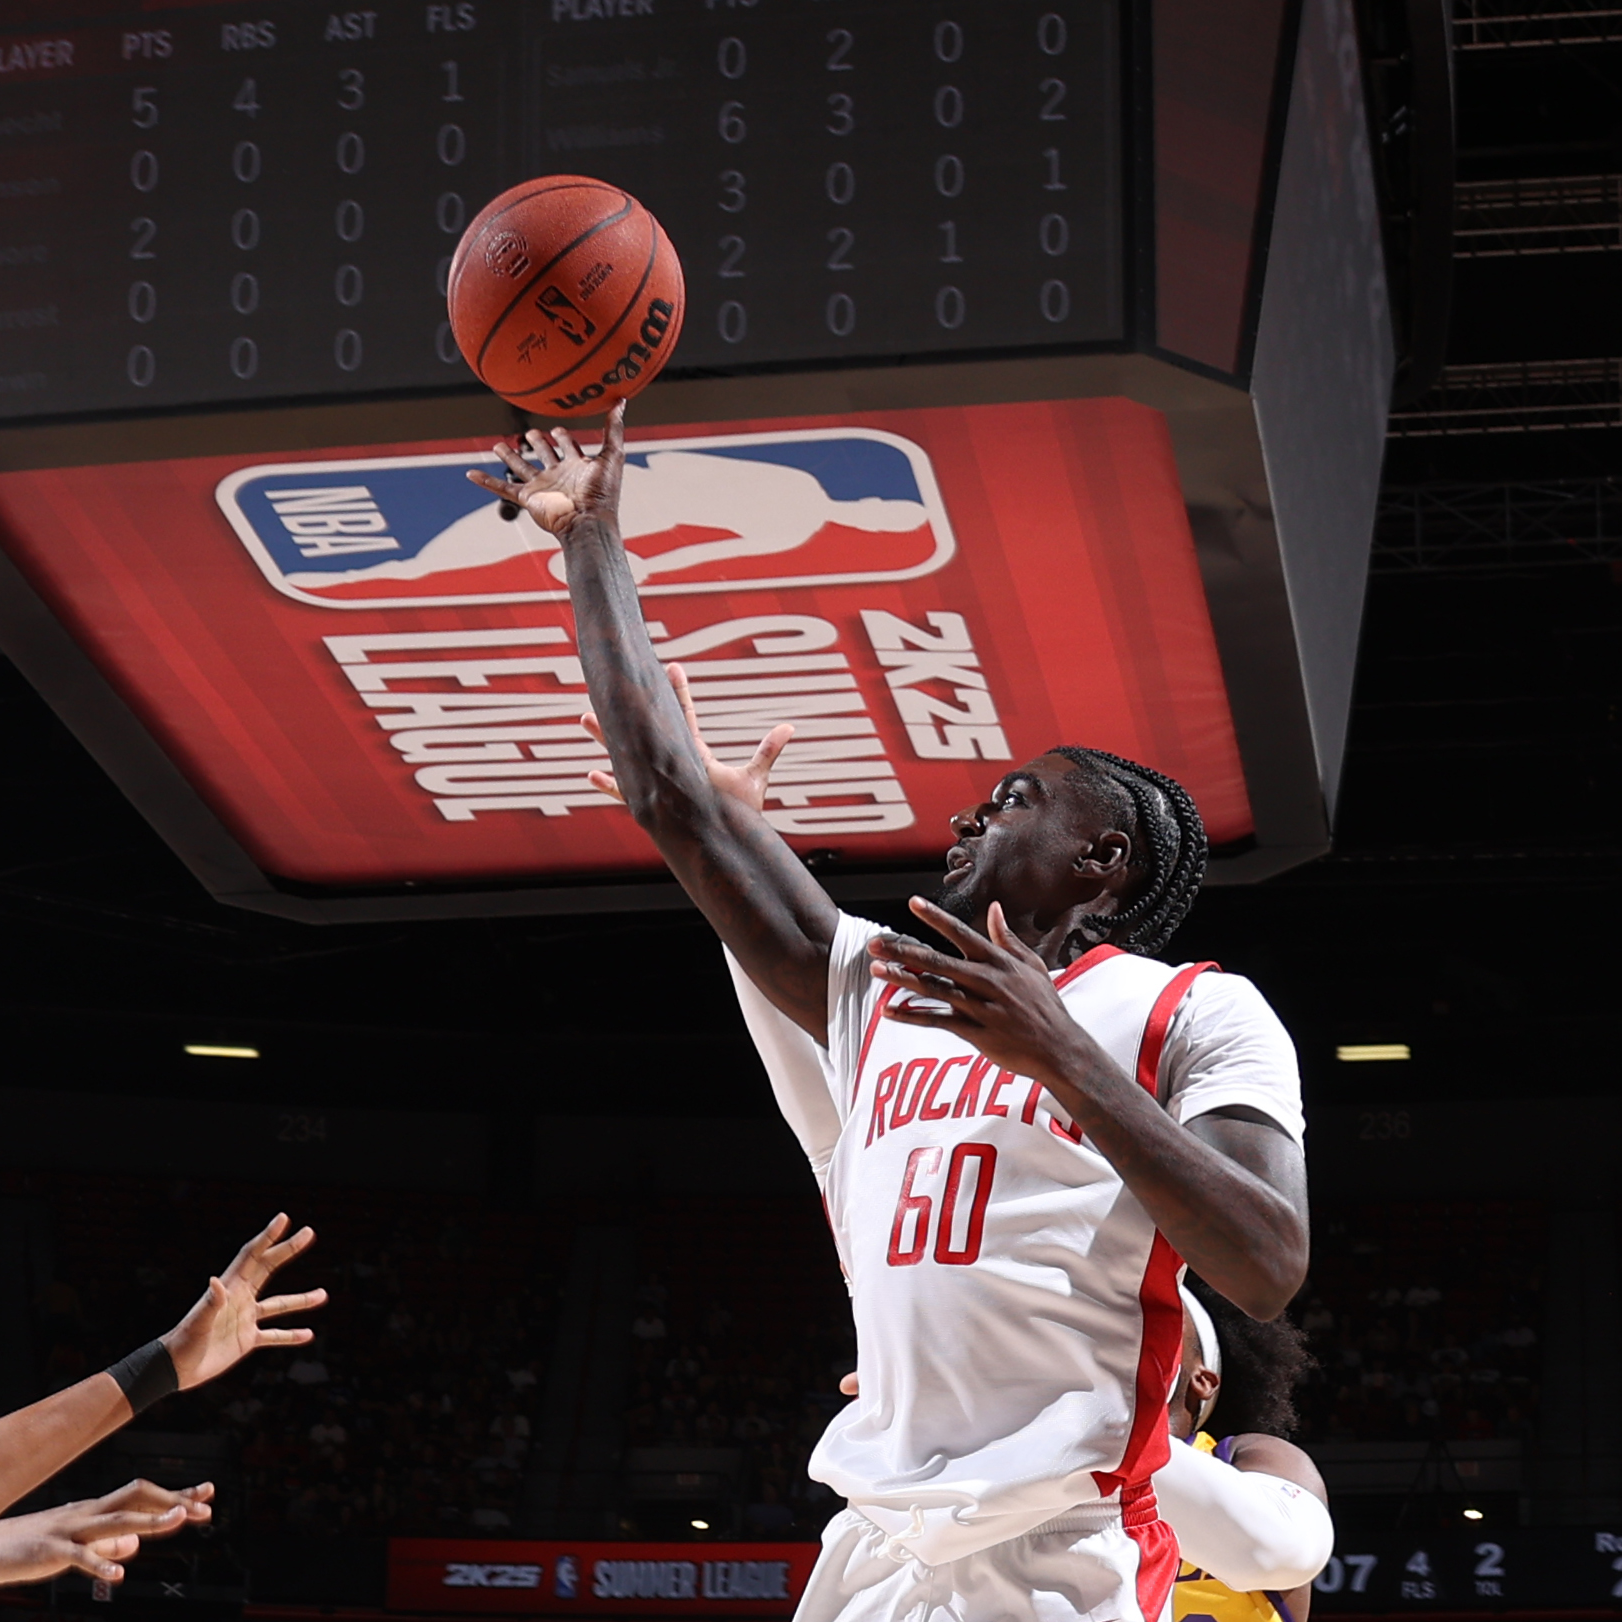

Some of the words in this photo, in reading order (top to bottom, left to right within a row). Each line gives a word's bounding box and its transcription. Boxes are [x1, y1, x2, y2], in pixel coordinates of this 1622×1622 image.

[122, 32, 173, 59] PTS
[221, 22, 277, 51] RBS
[325, 12, 378, 41] AST
[426, 4, 475, 32] FLS
[718, 37, 747, 80] 0
[826, 28, 854, 72] 2
[933, 20, 963, 64] 0
[1038, 13, 1067, 56] 0
[131, 87, 159, 129] 5
[232, 77, 262, 118] 4
[336, 69, 365, 111] 3
[440, 60, 463, 103] 1
[718, 100, 747, 144] 6
[826, 93, 855, 136] 3
[934, 85, 964, 129] 0
[1038, 78, 1066, 121] 2
[130, 150, 159, 193] 0
[232, 140, 261, 184] 0
[336, 131, 365, 174] 0
[436, 123, 465, 167] 0
[718, 169, 747, 213] 3
[825, 161, 855, 205] 0
[934, 154, 964, 198] 0
[1043, 147, 1065, 191] 1
[129, 216, 158, 260] 2
[231, 208, 260, 250] 0
[335, 199, 364, 243] 0
[436, 192, 465, 234] 0
[718, 235, 746, 278] 2
[826, 227, 854, 271] 2
[939, 220, 963, 263] 1
[1039, 213, 1068, 257] 0
[128, 281, 157, 324] 0
[230, 272, 260, 315] 0
[334, 264, 363, 307] 0
[717, 300, 746, 344] 0
[825, 292, 855, 336] 0
[935, 286, 965, 330] 0
[1040, 279, 1069, 322] 0
[127, 344, 156, 387] 0
[229, 336, 259, 380] 0
[334, 329, 362, 372] 0
[550, 297, 675, 410] Wilson
[264, 484, 400, 560] NBA
[860, 609, 1013, 763] 2K25
[276, 1114, 328, 1143] 234
[886, 1141, 998, 1267] 60
[442, 1563, 545, 1589] 2K25
[591, 1560, 698, 1600] SUMMER
[701, 1561, 791, 1600] LEAGUE
[1402, 1581, 1436, 1600] FLS
[1406, 1550, 1431, 1577] 4
[1474, 1543, 1506, 1577] 2
